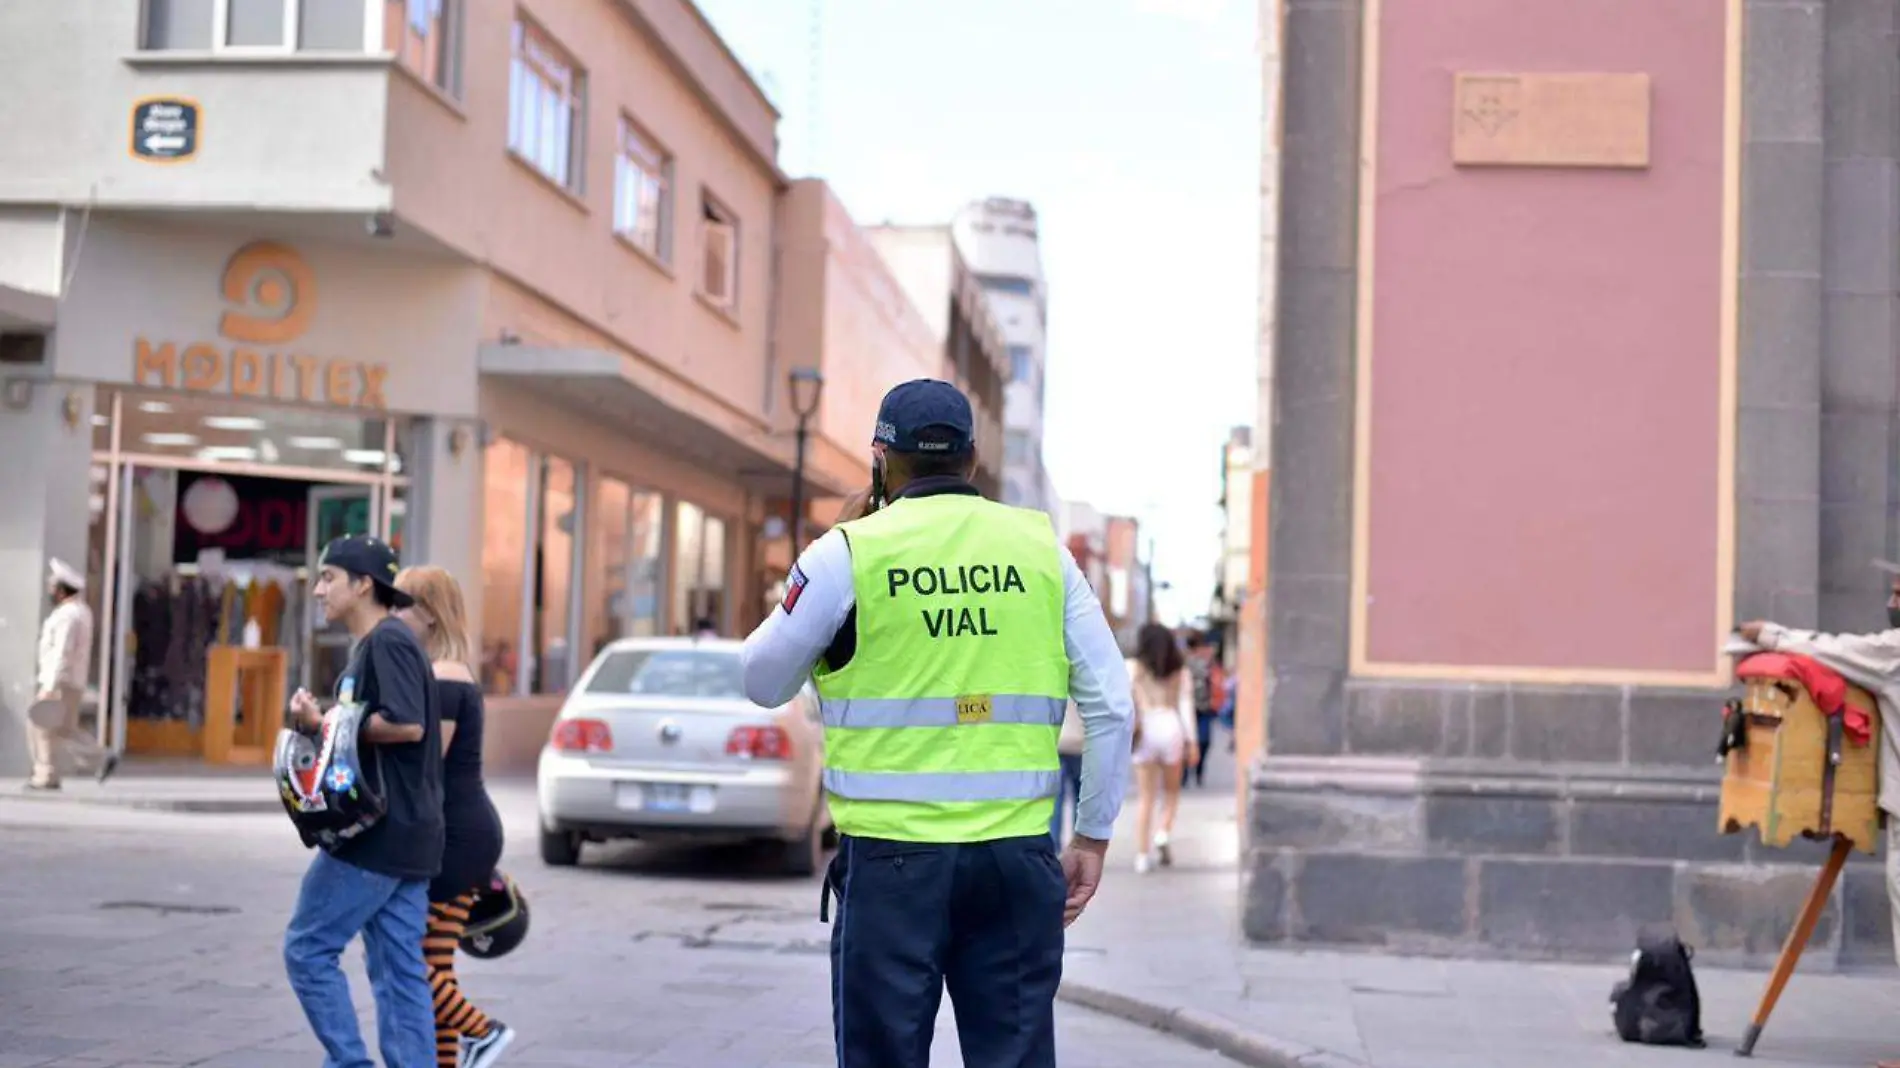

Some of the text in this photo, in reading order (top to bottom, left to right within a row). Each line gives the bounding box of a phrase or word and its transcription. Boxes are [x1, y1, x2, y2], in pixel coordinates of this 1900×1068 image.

[134, 338, 388, 409] MODITEX
[887, 564, 1026, 597] POLICIA
[921, 607, 998, 638] VIAL
